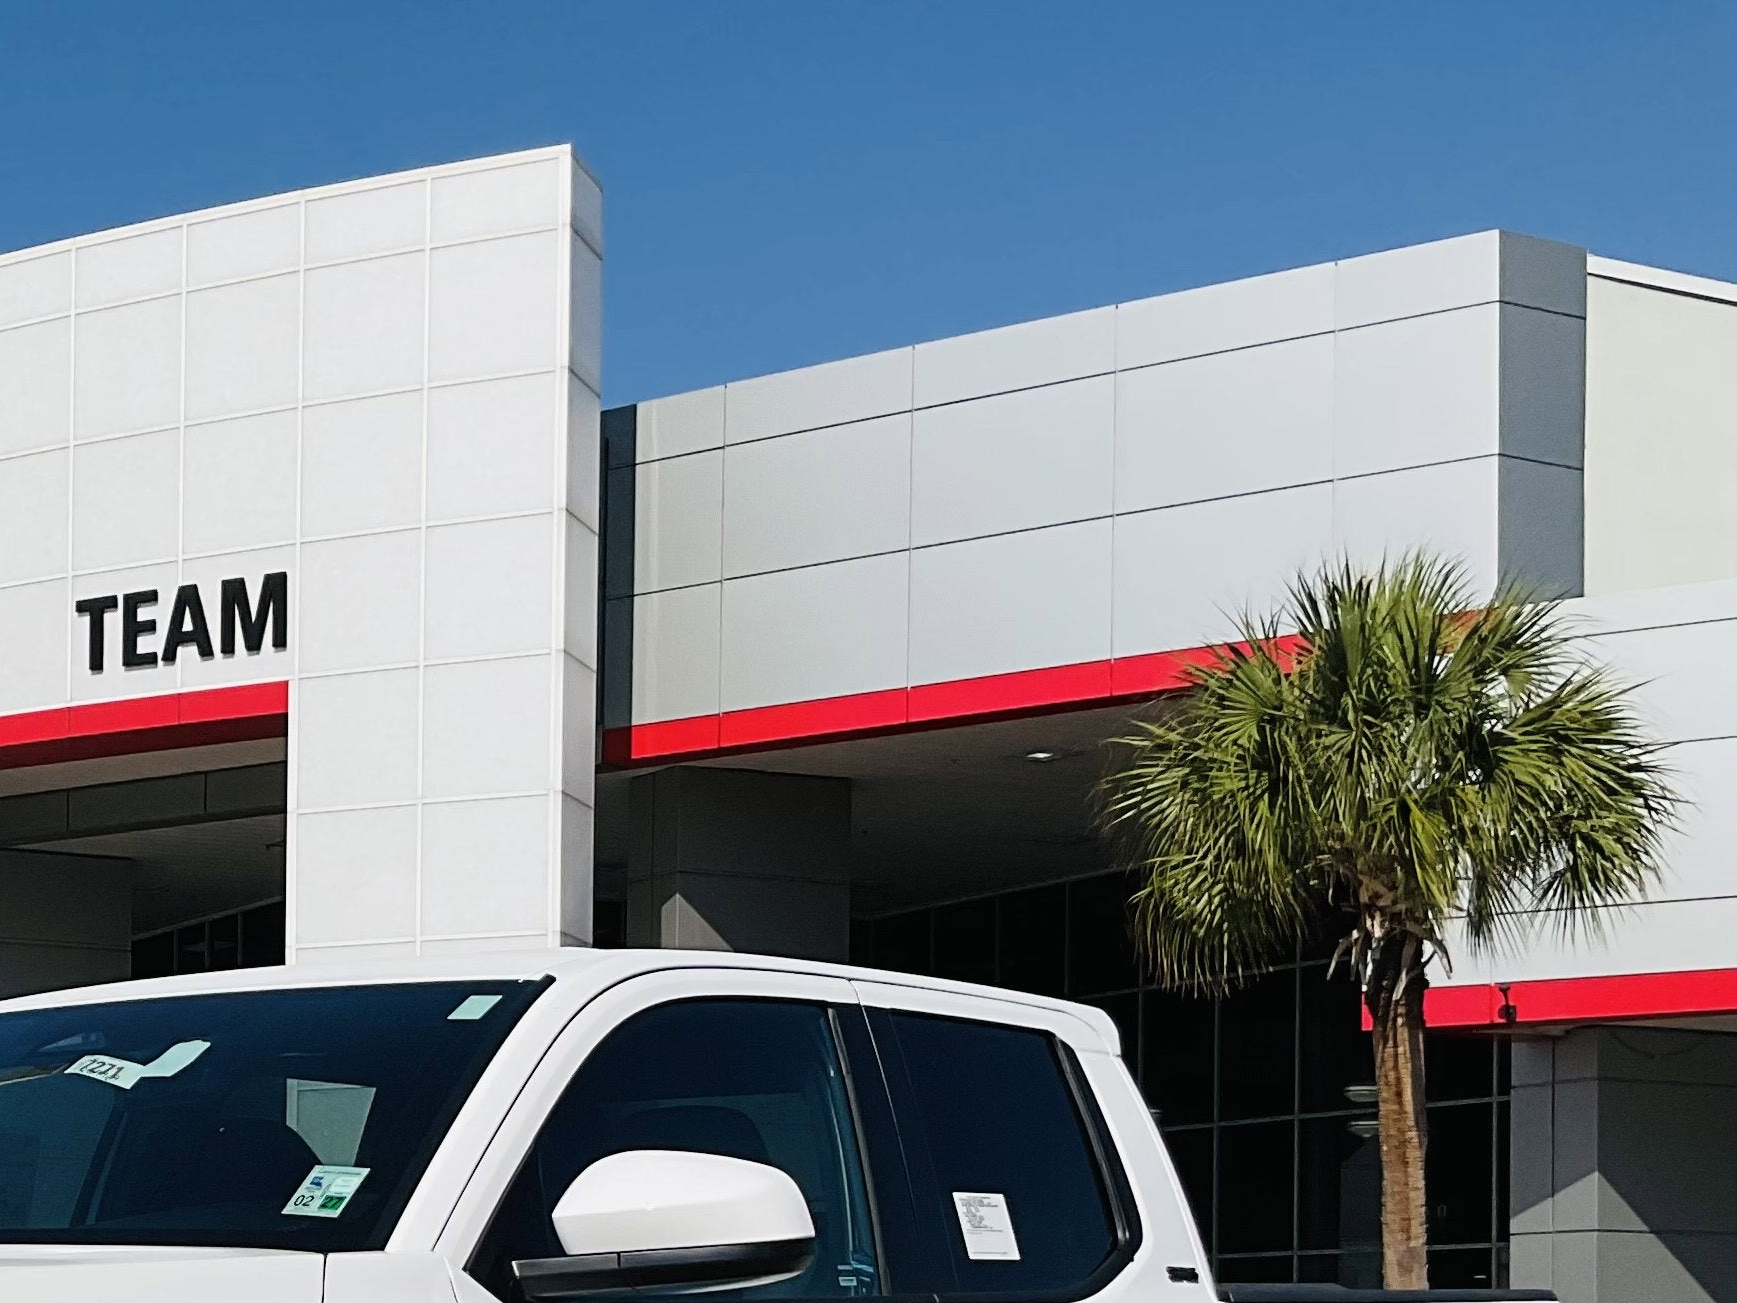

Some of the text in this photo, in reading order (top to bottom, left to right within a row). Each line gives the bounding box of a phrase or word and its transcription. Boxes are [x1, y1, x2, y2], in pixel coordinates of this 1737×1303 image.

[76, 571, 289, 672] TEAM
[293, 1194, 342, 1210] 02 27
